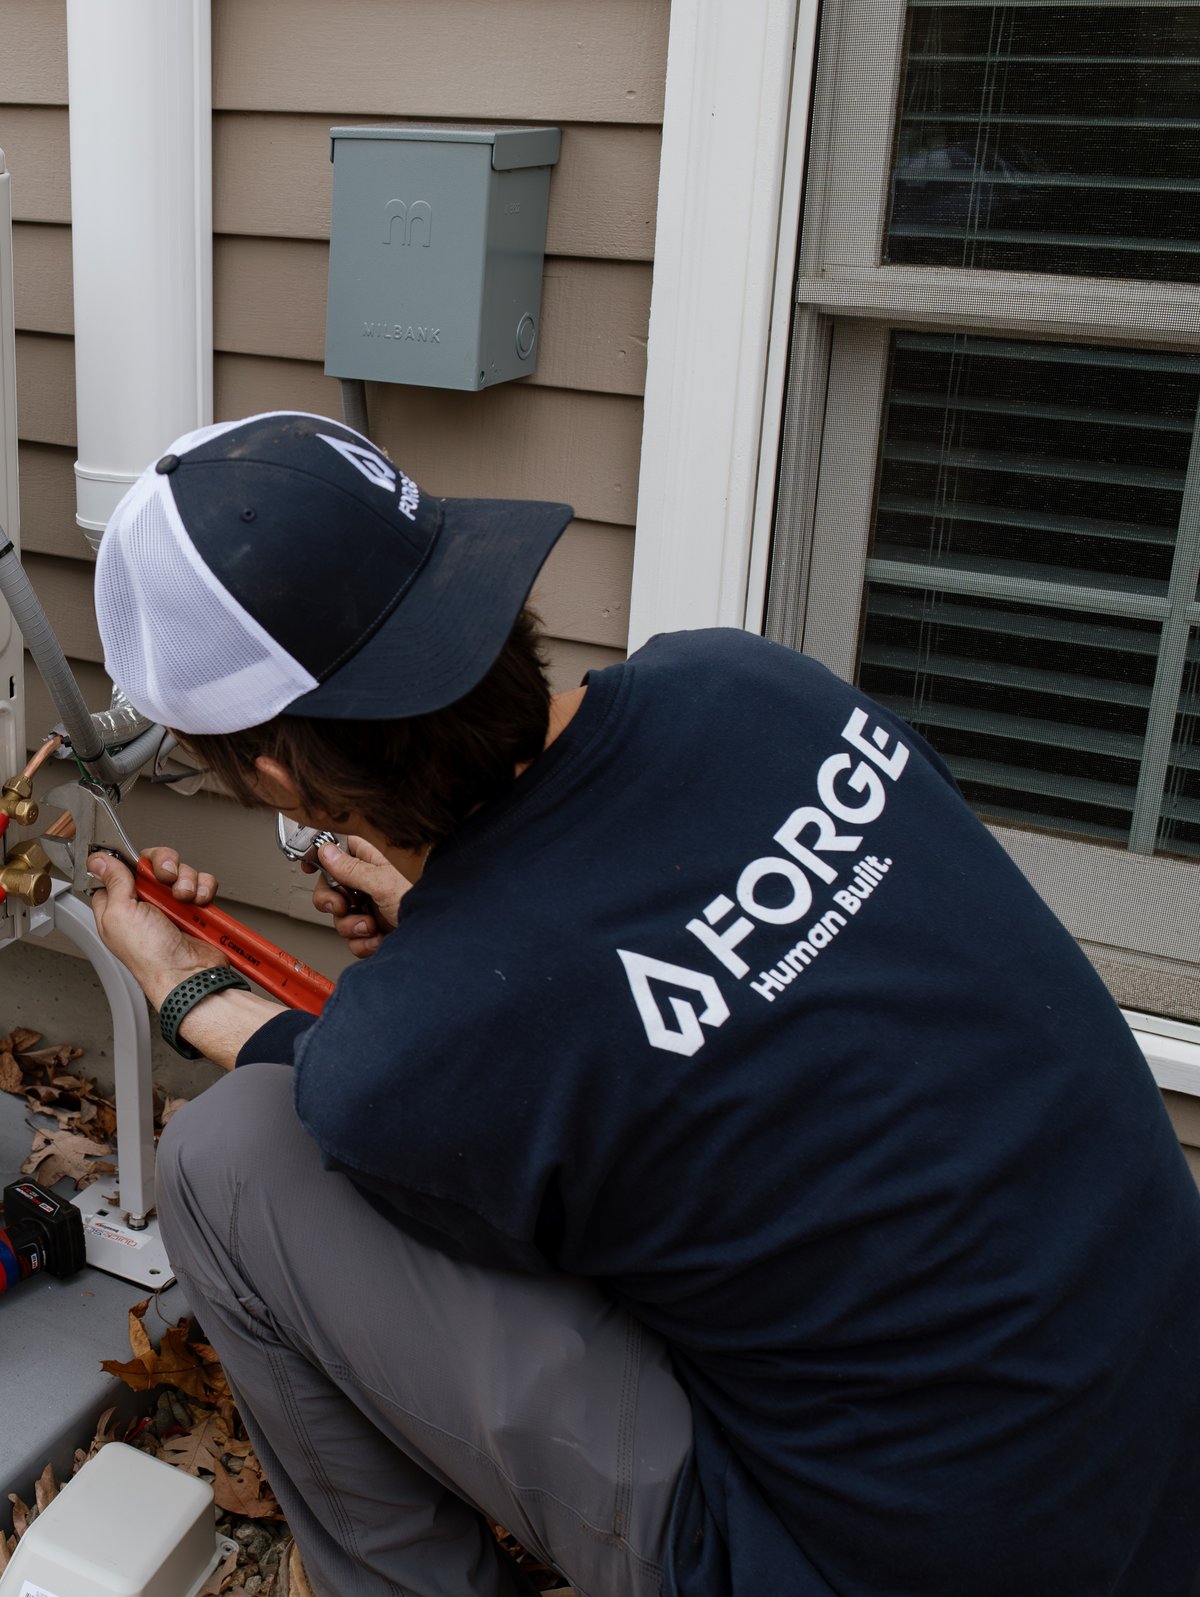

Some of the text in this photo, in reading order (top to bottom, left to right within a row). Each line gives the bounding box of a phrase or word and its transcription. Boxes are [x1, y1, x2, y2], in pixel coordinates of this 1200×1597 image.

[362, 321, 441, 344] MILBANK
[685, 707, 910, 980] FORGE
[192, 913, 207, 928] 12 IN
[749, 855, 894, 1003] Human Built.
[228, 941, 261, 967] CRESCENT
